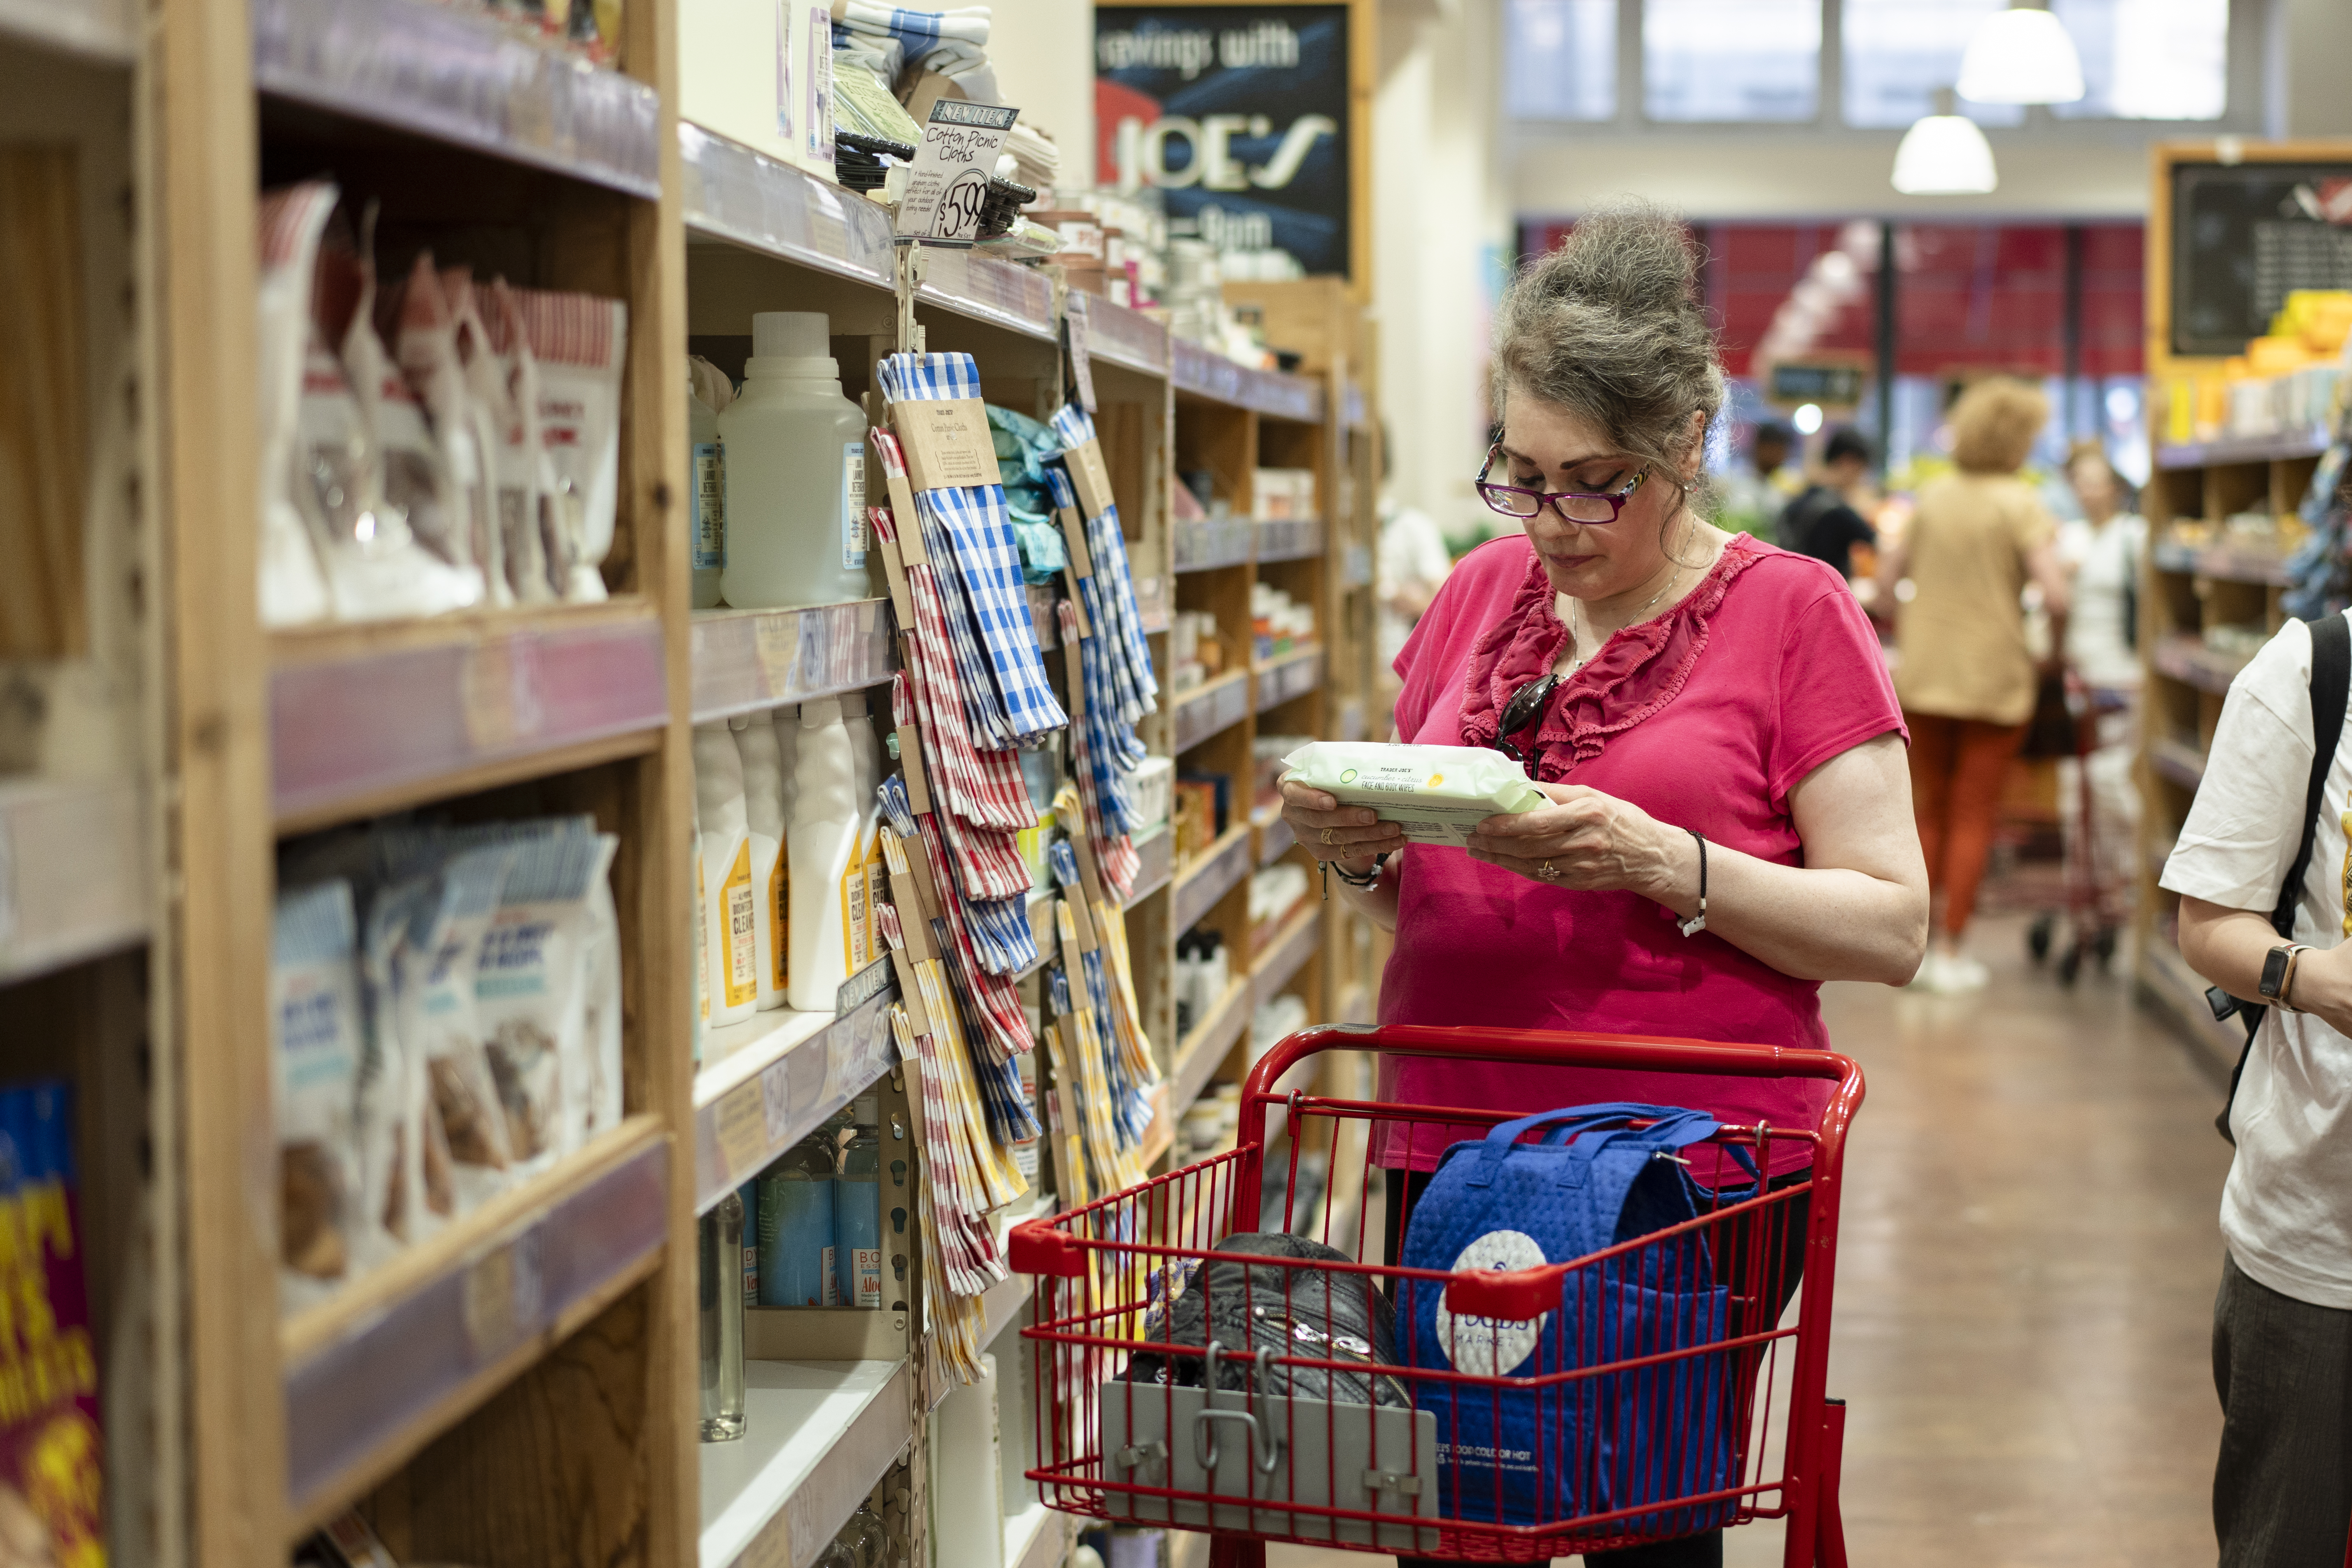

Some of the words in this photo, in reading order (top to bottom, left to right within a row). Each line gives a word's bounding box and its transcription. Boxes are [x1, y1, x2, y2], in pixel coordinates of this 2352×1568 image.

[942, 103, 974, 121] NEW
[971, 107, 1005, 126] ITEM
[927, 127, 964, 145] Cotton
[967, 131, 998, 149] Picnic
[940, 145, 974, 163] Cloths
[918, 170, 944, 178] Hand-finished
[911, 179, 927, 189] gingham
[906, 205, 917, 215] eating
[1362, 781, 1374, 790] FACE
[1374, 782, 1384, 791] AND
[1385, 782, 1398, 791] BODY
[1399, 783, 1415, 792] WIPES
[863, 962, 887, 999] ITEM
[860, 1252, 880, 1263] BO
